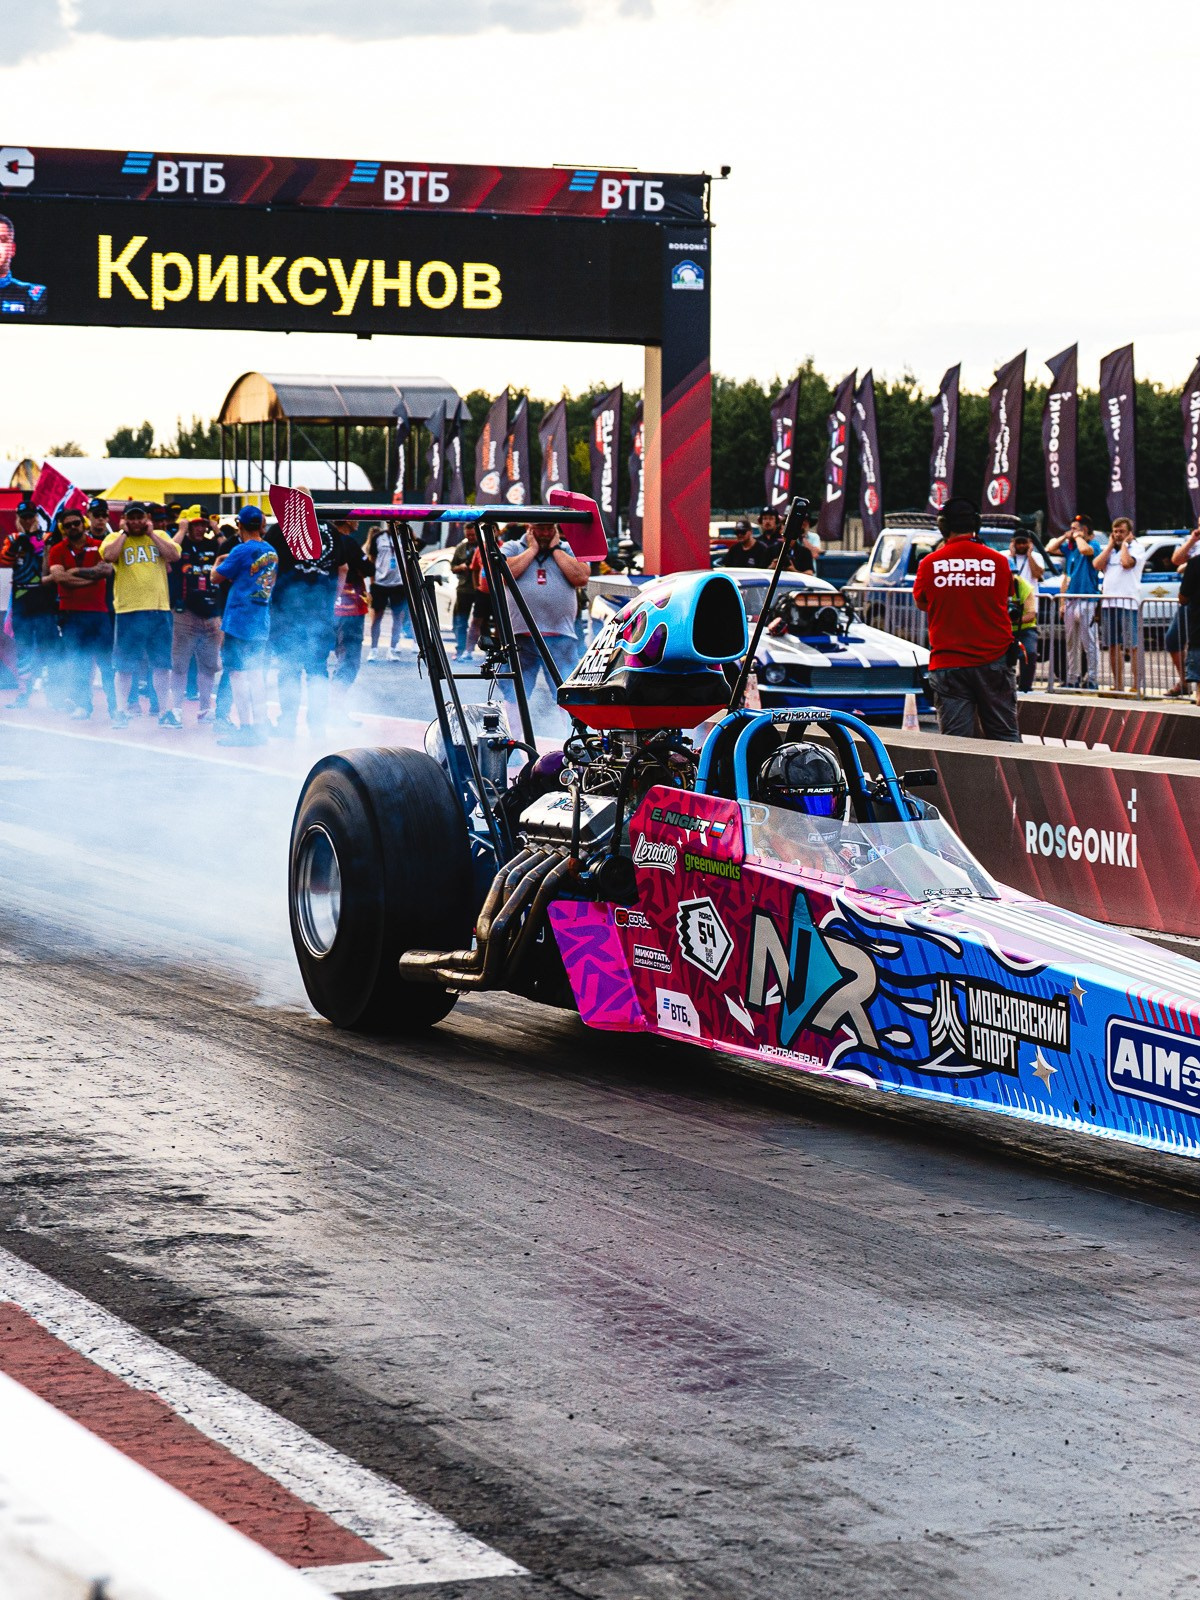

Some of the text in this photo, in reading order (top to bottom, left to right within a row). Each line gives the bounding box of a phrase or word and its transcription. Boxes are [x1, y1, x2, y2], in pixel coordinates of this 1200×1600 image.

[156, 160, 226, 194] ВТБ
[383, 169, 450, 203] ВТБ
[601, 178, 666, 212] ВТБ
[97, 234, 503, 316] Криксунов
[123, 545, 161, 565] GAP
[933, 558, 996, 574] RDRC
[933, 573, 996, 588] Official
[664, 810, 711, 833] NIGHT
[1025, 820, 1138, 868] ROSGONKI
[684, 854, 741, 880] greenworks
[697, 921, 717, 948] 54
[670, 1003, 688, 1024] ВТБ
[968, 986, 1068, 1046] МОСКОВСКИЙ
[971, 1025, 1019, 1070] СПОРТ
